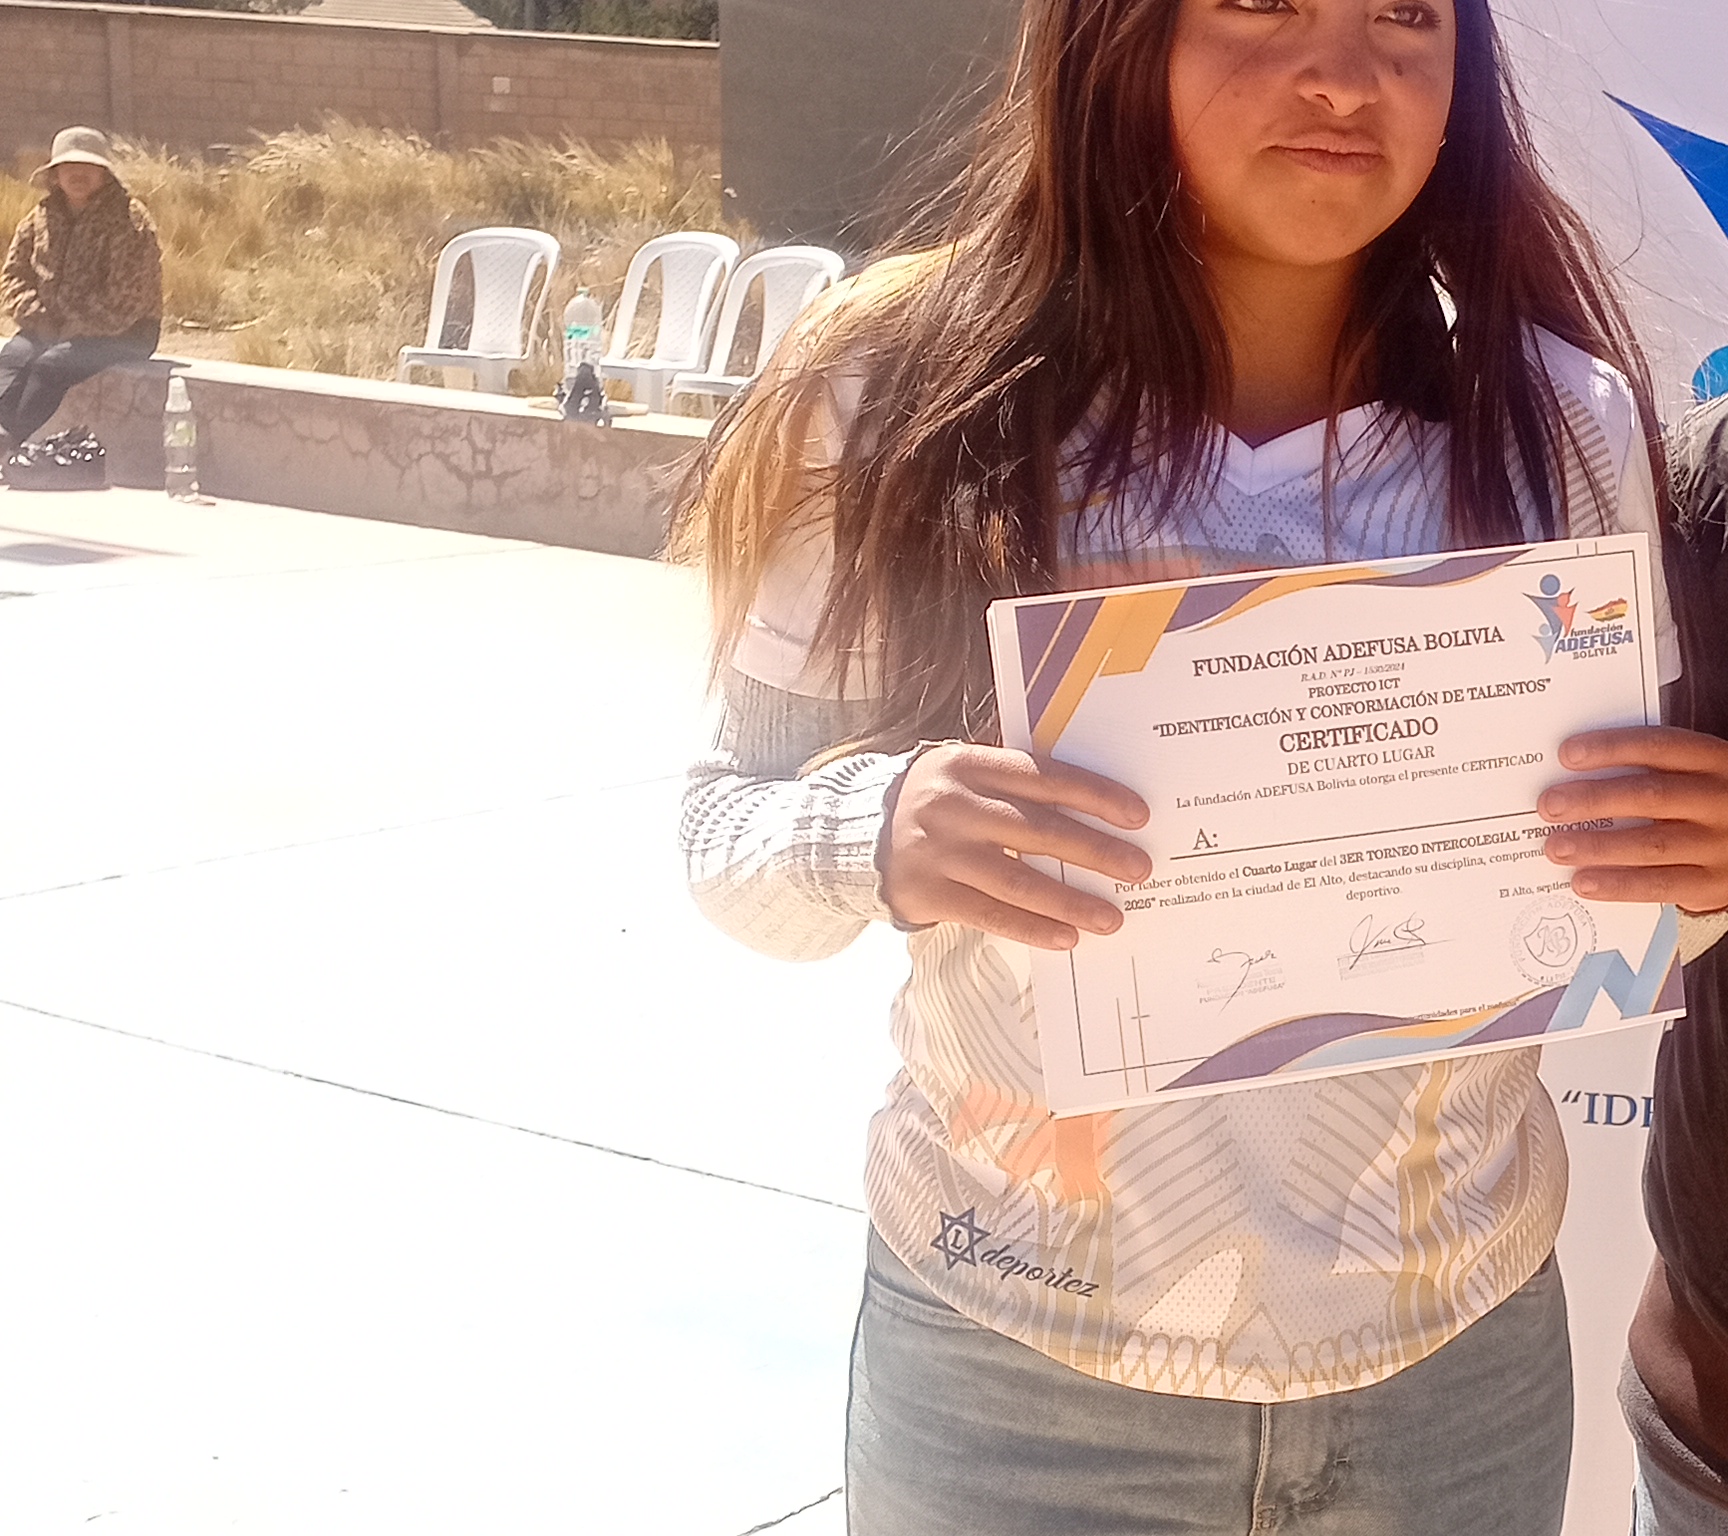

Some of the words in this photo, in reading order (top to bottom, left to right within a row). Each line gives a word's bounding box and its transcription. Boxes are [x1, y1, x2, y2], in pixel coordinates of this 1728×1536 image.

[1192, 644, 1318, 676] FUNDACIÓN
[1322, 636, 1421, 663] ADEFUSA
[1423, 626, 1505, 651] BOLIVIA
[1555, 630, 1634, 653] ADEFUSA
[1573, 646, 1618, 660] BOLIVIA
[1308, 681, 1376, 699] PROYECTO
[1379, 677, 1400, 691] ICT
[1295, 707, 1307, 721] Y
[1310, 690, 1438, 720] CONFORMACIÓN
[1442, 689, 1464, 704] DE
[1279, 716, 1438, 753] CERTIFICADO
[1287, 761, 1310, 776] DE
[1314, 752, 1379, 773] CUARTO
[1382, 745, 1436, 764] LUGAR
[1176, 797, 1191, 809] La
[1194, 790, 1251, 807] fundación
[1254, 782, 1315, 800] ADEFUSA
[1317, 778, 1356, 792] Bolivia
[1359, 772, 1396, 786] otorga
[1398, 770, 1409, 781] el
[1411, 765, 1459, 782] presente
[1461, 752, 1544, 773] CERTIFICADO
[1192, 828, 1218, 851] A:
[1114, 881, 1136, 894] Por
[1174, 871, 1226, 887] obtenido
[1229, 868, 1239, 879] el
[1242, 864, 1282, 878] Cuarto
[1284, 859, 1317, 874] Lugar
[1319, 855, 1337, 868] del
[1339, 851, 1364, 865] 3ER
[1366, 844, 1419, 862] TORNEO
[1421, 830, 1520, 855] INTERCOLEGIAL
[1159, 892, 1212, 908] realizado
[1214, 890, 1230, 901] en
[1232, 887, 1243, 899] la
[1245, 882, 1284, 896] ciudad
[1286, 879, 1301, 891] de
[1303, 877, 1316, 889] El
[1319, 875, 1346, 888] Alto,
[1348, 865, 1412, 884] destacando
[1414, 863, 1429, 875] su
[1430, 854, 1486, 873] disciplina,
[1499, 888, 1509, 898] El
[1512, 885, 1535, 897] Alto,
[979, 1244, 1101, 1298] deportez
